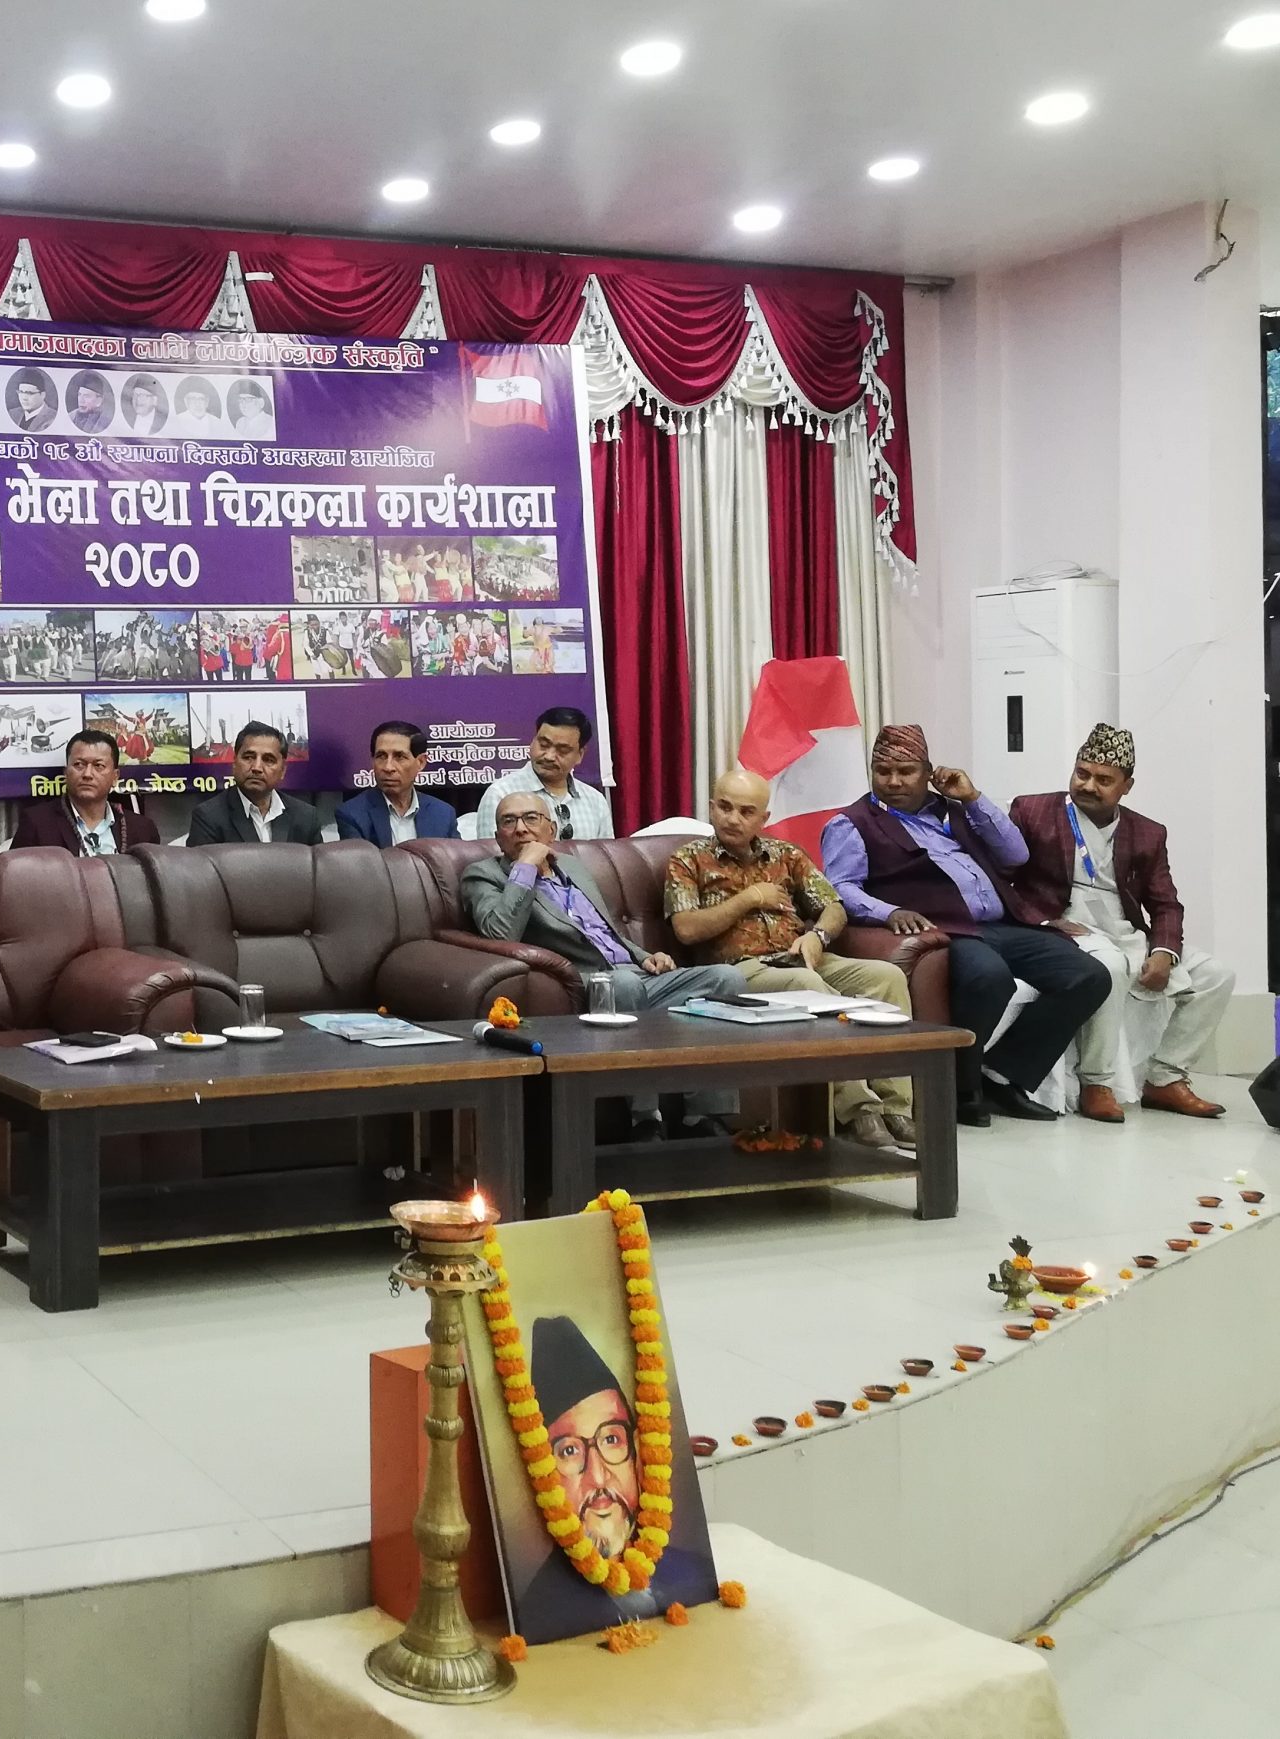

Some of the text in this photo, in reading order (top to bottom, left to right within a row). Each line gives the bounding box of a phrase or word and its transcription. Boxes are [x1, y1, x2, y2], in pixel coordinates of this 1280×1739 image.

[132, 333, 190, 360] लागि
[43, 442, 70, 461] १८
[107, 444, 178, 464] स्थापना
[183, 441, 258, 466] दिवसको
[262, 448, 346, 468] अवसरमा
[350, 445, 435, 469] आयोजित
[5, 462, 99, 524] भेला
[109, 479, 192, 526] तथा
[200, 470, 368, 528] चित्रकला
[375, 473, 558, 529] कार्यशाला
[85, 542, 200, 589] २०८०
[429, 721, 496, 739] आयोजक
[193, 776, 217, 792] १०
